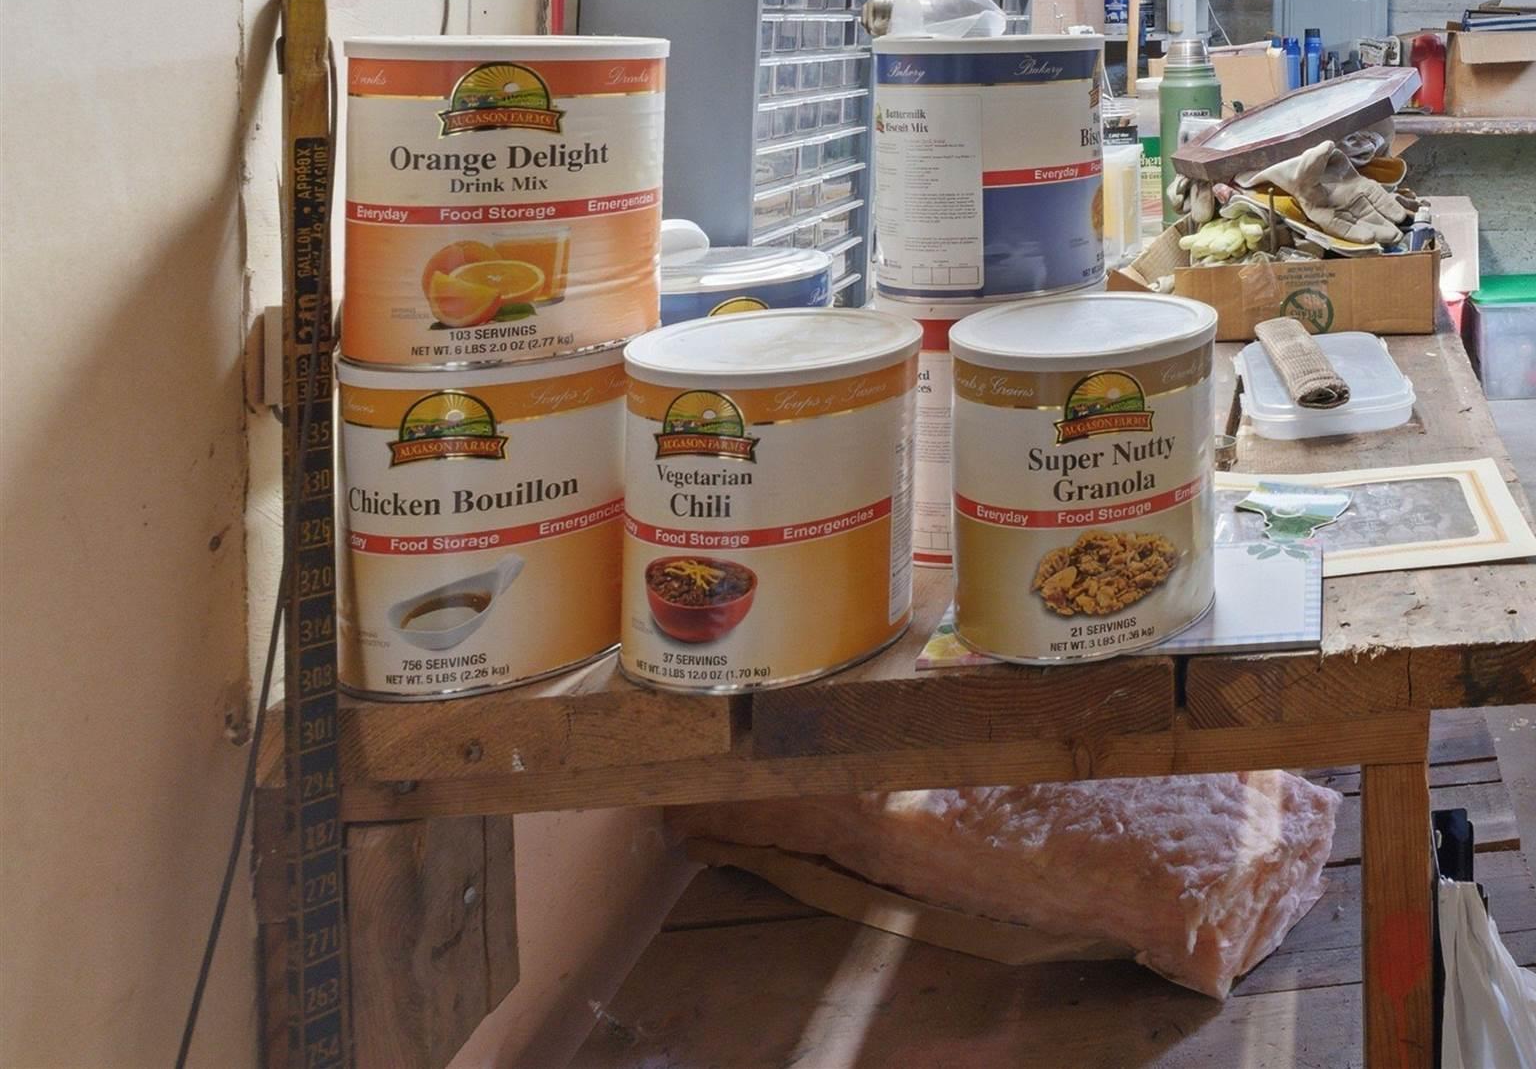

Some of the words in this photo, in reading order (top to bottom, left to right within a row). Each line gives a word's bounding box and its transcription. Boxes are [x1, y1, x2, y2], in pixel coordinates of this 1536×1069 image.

[450, 113, 507, 127] AUGASON
[509, 112, 552, 126] FARMS
[390, 145, 497, 177] Orange
[507, 143, 609, 170] Delight
[296, 147, 312, 200] APPROX
[1034, 167, 1079, 181] Everyday
[450, 177, 503, 194] Drink
[511, 177, 548, 192] Mix
[356, 205, 408, 222] Everyday
[440, 208, 482, 222] Food
[488, 205, 556, 220] Storage
[588, 193, 655, 213] Emergencies
[296, 226, 312, 279] GALLON
[449, 330, 470, 341] 103
[474, 324, 537, 340] SERVINGS
[411, 346, 437, 356] NET
[464, 344, 487, 354] LBS
[489, 342, 508, 353] 2.0
[509, 341, 525, 352] OZ
[528, 338, 554, 352] (2.77
[556, 333, 574, 347] kg)
[1064, 417, 1111, 437] AUGASON
[399, 442, 451, 457] AUGASON
[454, 442, 497, 453] FARMS
[1028, 448, 1105, 477] Super
[1112, 435, 1176, 466] Nutty
[656, 464, 752, 487] Vegetarian
[349, 487, 441, 516] Chicken
[451, 478, 579, 514] Bouillon
[1053, 472, 1156, 503] Granola
[670, 493, 731, 518] Chili
[977, 505, 1029, 526] Everyday
[1058, 512, 1094, 524] Food
[1098, 501, 1152, 521] Storage
[655, 529, 686, 543] Food
[689, 532, 750, 547] Storage
[783, 507, 874, 540] Emergencies
[390, 538, 429, 551] Food
[433, 533, 499, 550] Storage
[301, 566, 332, 592] 320
[1071, 627, 1083, 637] 21
[1086, 617, 1137, 635] SERVINGS
[1050, 641, 1068, 652] NET
[1097, 634, 1115, 647] LBS
[402, 660, 422, 670] 756
[426, 653, 487, 670] SERVINGS
[663, 653, 675, 664] 37
[676, 653, 727, 666] SERVINGS
[386, 674, 406, 685] NET
[435, 672, 457, 683] LBS
[491, 664, 510, 677] kg)
[669, 667, 686, 679] LBS
[709, 669, 723, 680] OZ
[726, 669, 752, 681] (1.70
